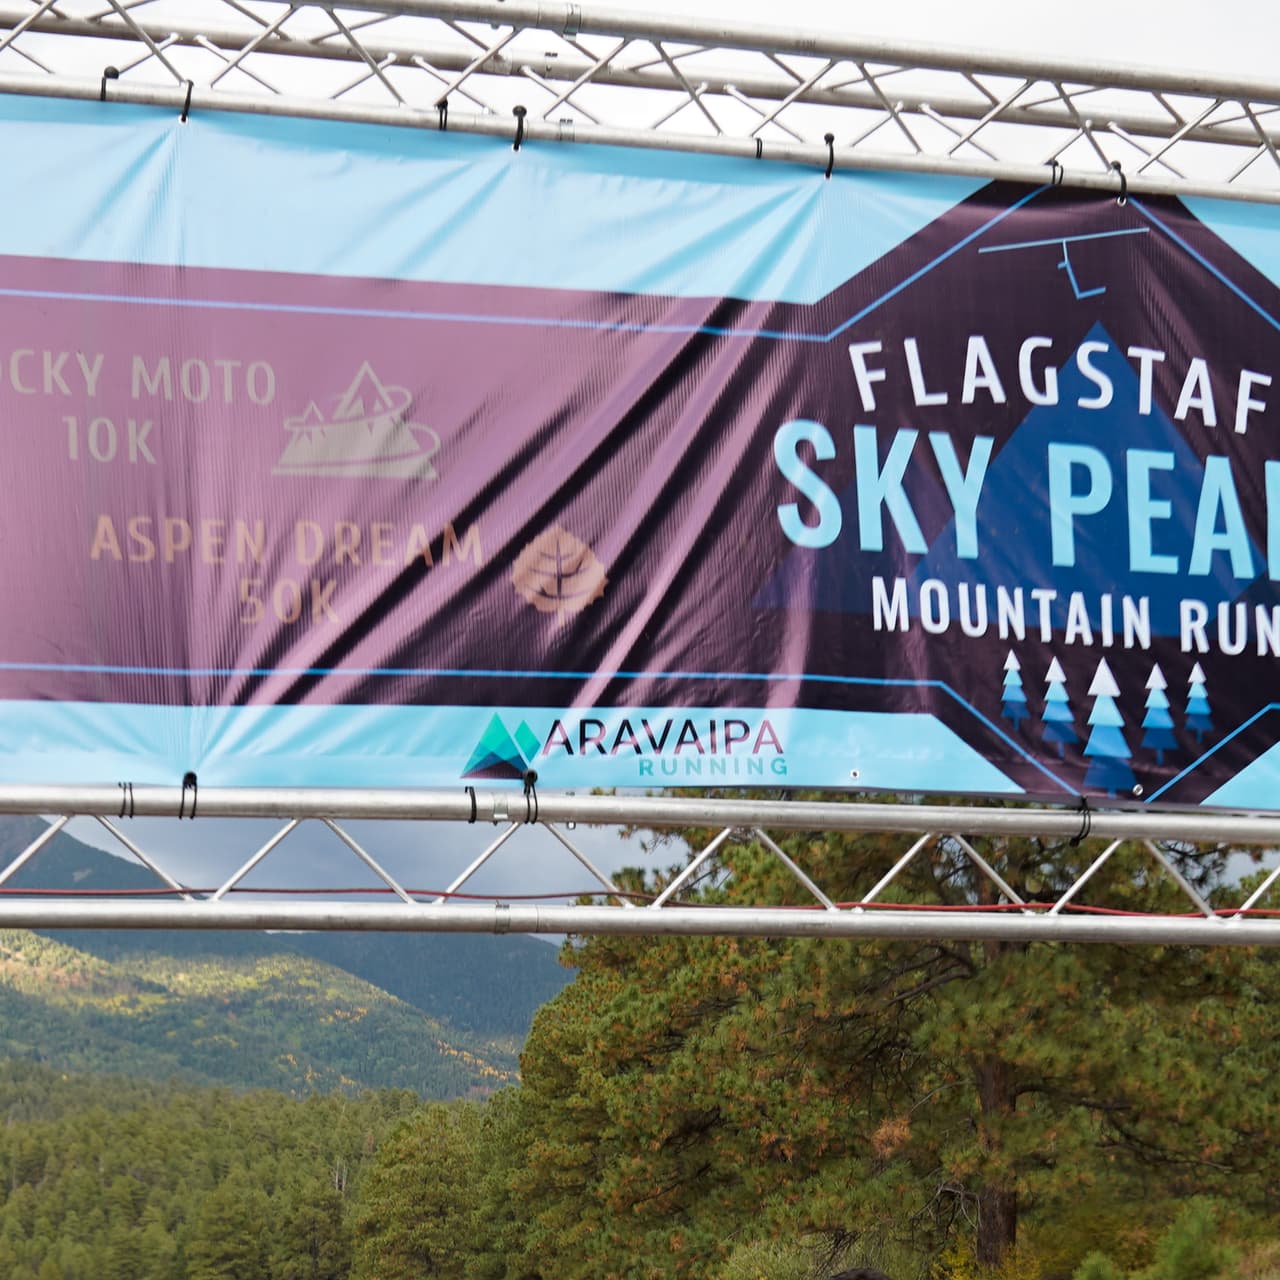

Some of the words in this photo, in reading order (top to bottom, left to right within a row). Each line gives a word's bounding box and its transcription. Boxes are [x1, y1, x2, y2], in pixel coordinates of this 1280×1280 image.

[131, 356, 276, 405] MOTO
[63, 416, 157, 465] 10K
[773, 418, 994, 560] SKY
[90, 515, 266, 565] ASPEN
[295, 519, 485, 568] DREAM
[239, 577, 340, 625] 50K
[871, 575, 1153, 649] MOUNTAIN
[541, 719, 785, 755] ARAVAIPA
[638, 757, 788, 777] RUNNING
